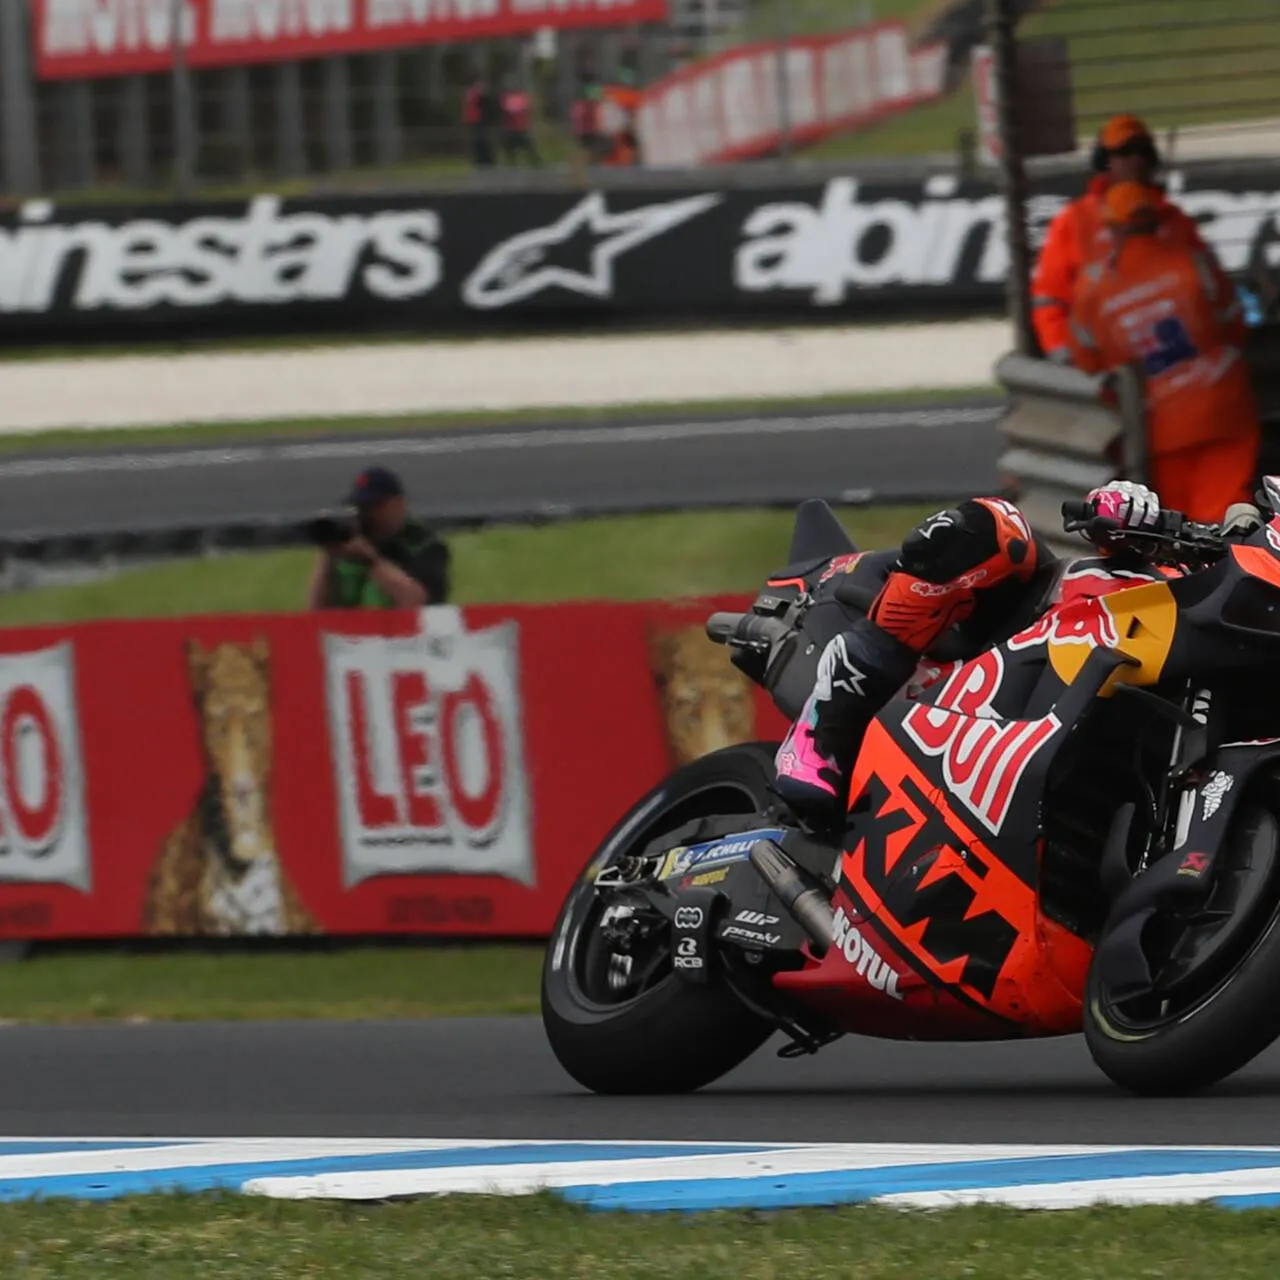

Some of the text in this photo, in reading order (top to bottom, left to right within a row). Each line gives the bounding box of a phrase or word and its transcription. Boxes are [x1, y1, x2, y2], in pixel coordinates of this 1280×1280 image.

[346, 668, 506, 831] LEO
[901, 646, 1062, 837] Bull
[674, 956, 703, 968] RCB
[832, 905, 904, 1000] MOTUL
[845, 770, 1021, 1002] KTM
